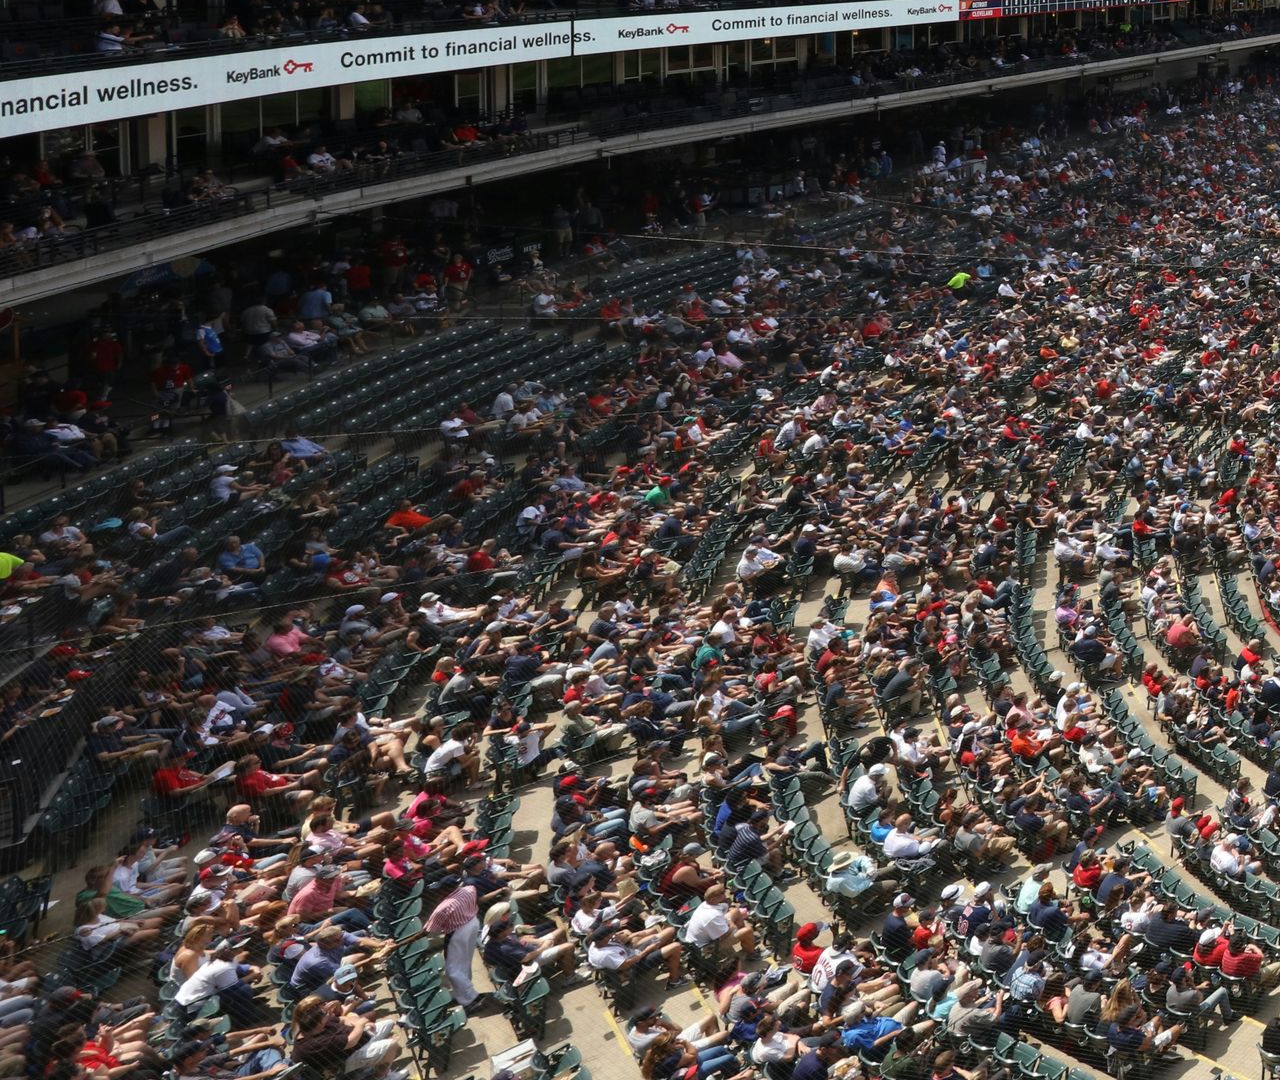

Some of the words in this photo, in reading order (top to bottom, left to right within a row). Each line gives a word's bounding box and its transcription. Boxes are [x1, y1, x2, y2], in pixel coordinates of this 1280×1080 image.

[712, 16, 766, 32] Commit
[769, 15, 783, 27] to
[786, 10, 839, 26] financial
[842, 8, 893, 21] wellness.
[907, 6, 937, 17] KeyBank
[618, 26, 664, 40] KeyBank
[340, 46, 415, 69] Commit
[421, 44, 439, 60] to
[445, 35, 517, 57] financial
[522, 30, 596, 49] wellness.
[226, 65, 281, 84] KeyBank
[97, 74, 199, 103] wellness.
